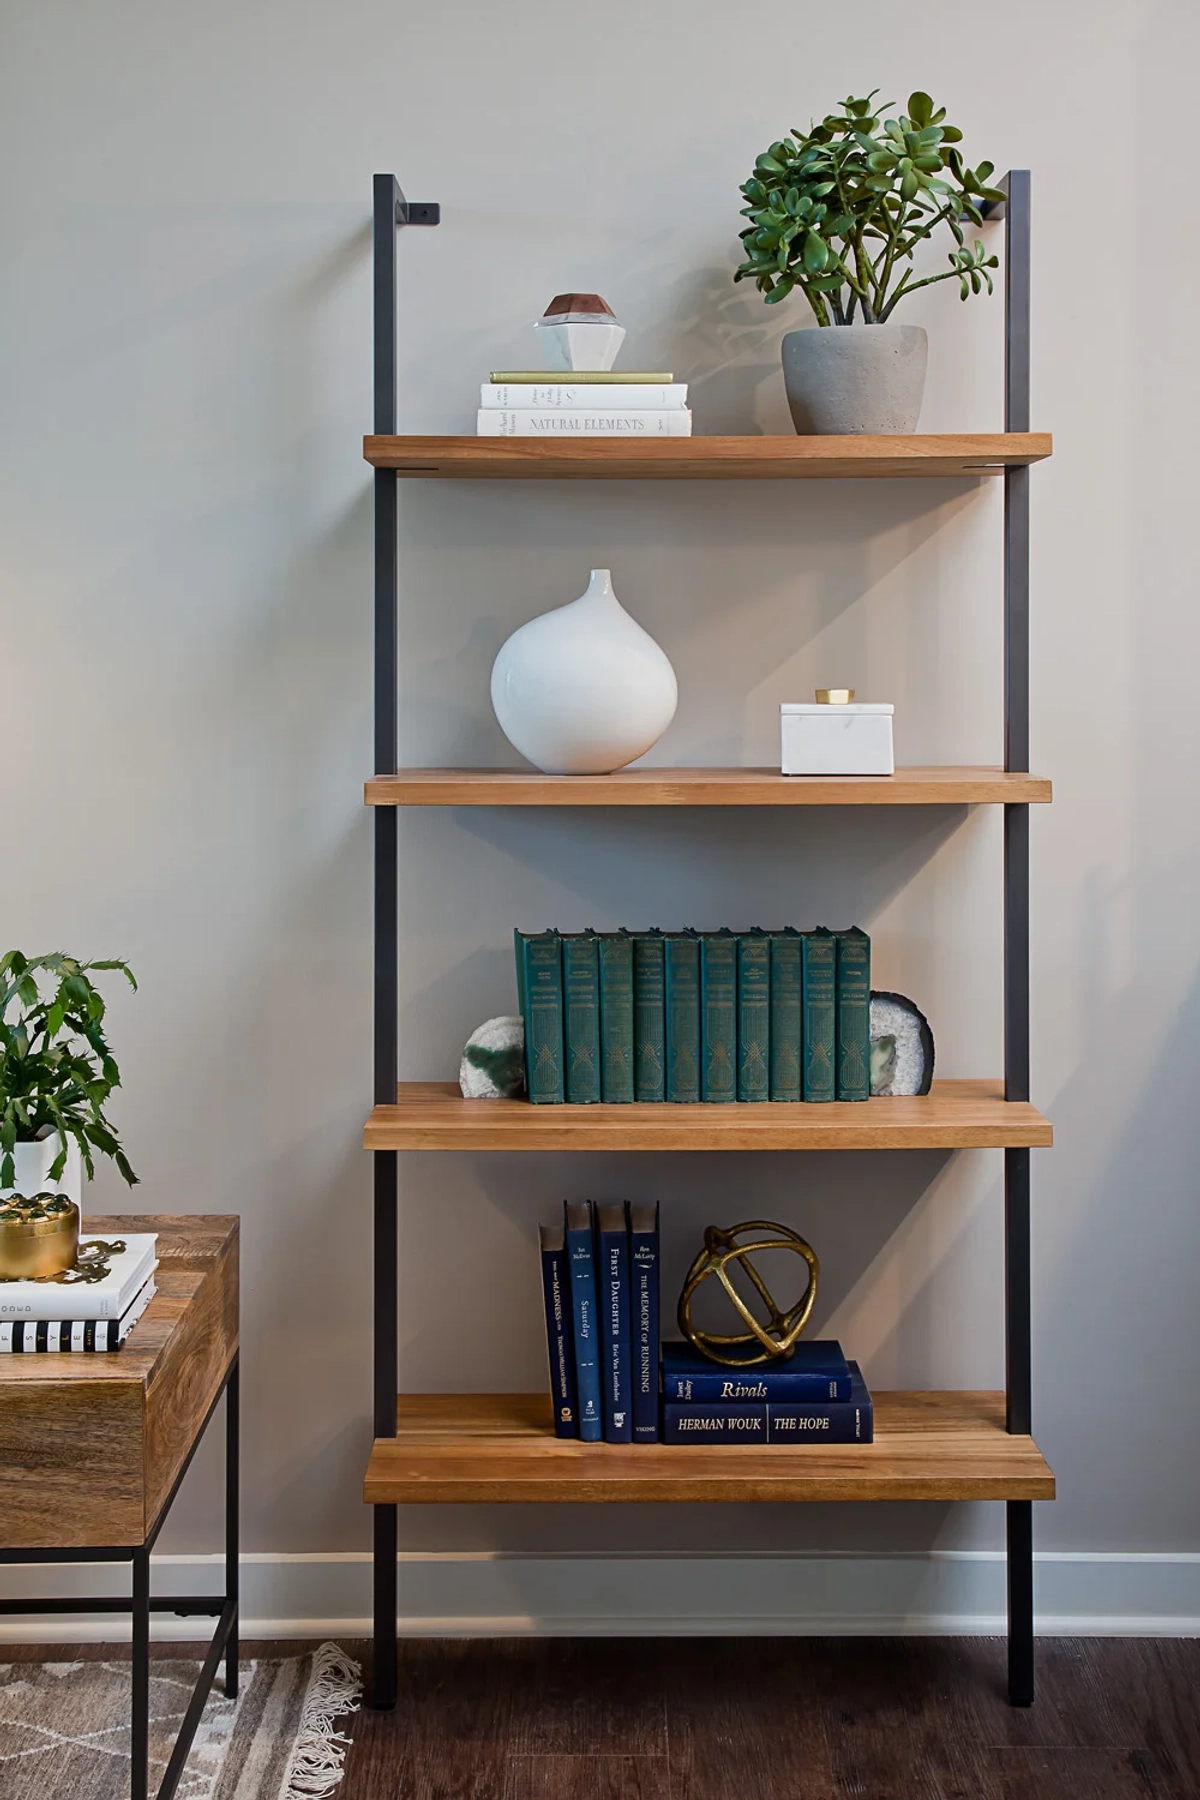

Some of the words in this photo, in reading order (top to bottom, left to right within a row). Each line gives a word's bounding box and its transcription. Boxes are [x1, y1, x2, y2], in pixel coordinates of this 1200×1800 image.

[530, 418, 581, 430] NATURAL
[584, 418, 645, 430] ELEMENTS
[610, 1248, 619, 1277] FIRST
[640, 1275, 648, 1290] THE
[552, 1280, 562, 1320] MADNESS
[610, 1281, 620, 1336] DAUGHTER
[580, 1300, 590, 1338] Saturday
[641, 1291, 649, 1332] MEMORY
[612, 1357, 620, 1370] Van
[641, 1346, 650, 1393] RUNNING
[676, 1381, 684, 1398] Janet
[685, 1380, 693, 1400] Dailey
[720, 1382, 768, 1397] Rivals
[678, 1418, 724, 1430] HERMAN
[727, 1418, 762, 1430] WOUK
[774, 1418, 796, 1430] THE
[798, 1418, 830, 1430] HOPE
